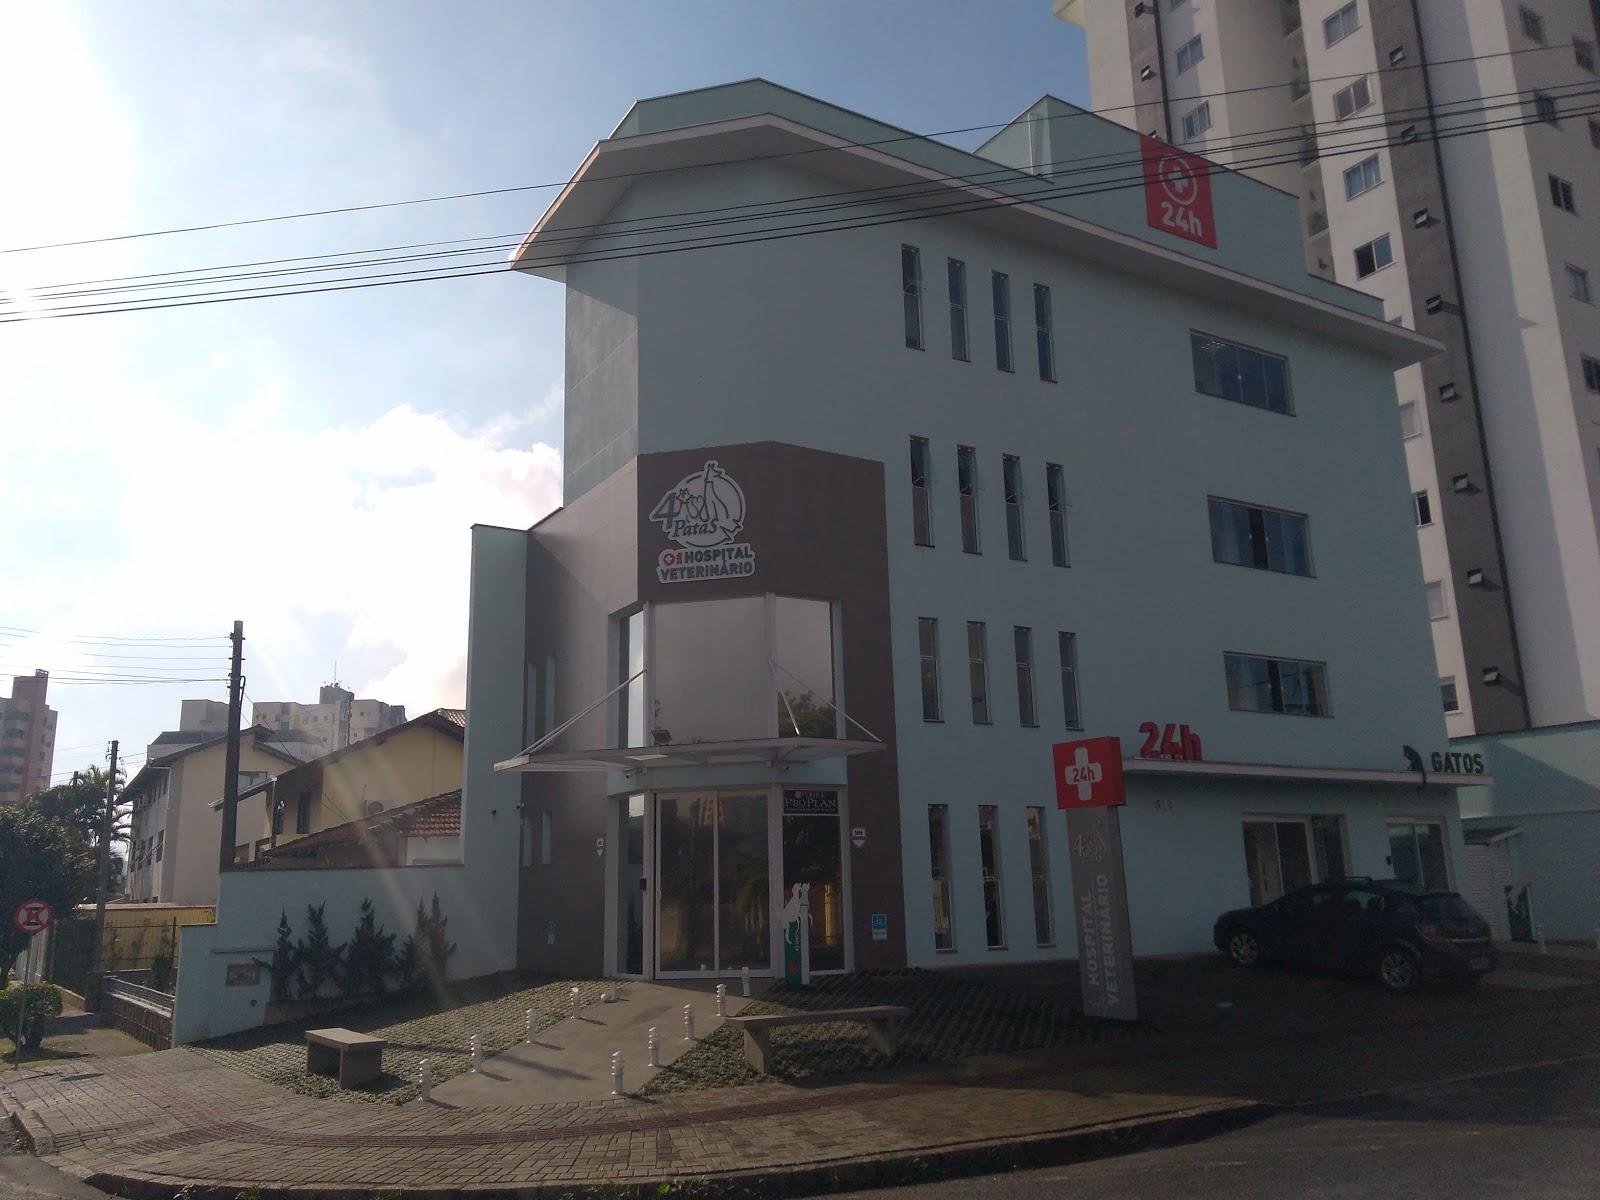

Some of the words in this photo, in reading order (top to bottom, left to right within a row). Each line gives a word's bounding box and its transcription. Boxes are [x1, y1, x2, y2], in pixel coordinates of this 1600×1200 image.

[1161, 200, 1202, 237] 24h
[652, 492, 681, 529] 4
[684, 546, 752, 564] HOSPITAL
[1139, 721, 1203, 761] 24h
[1072, 766, 1095, 783] 24h
[1431, 751, 1484, 774] GATOS
[1080, 890, 1100, 987] HOSPITAL
